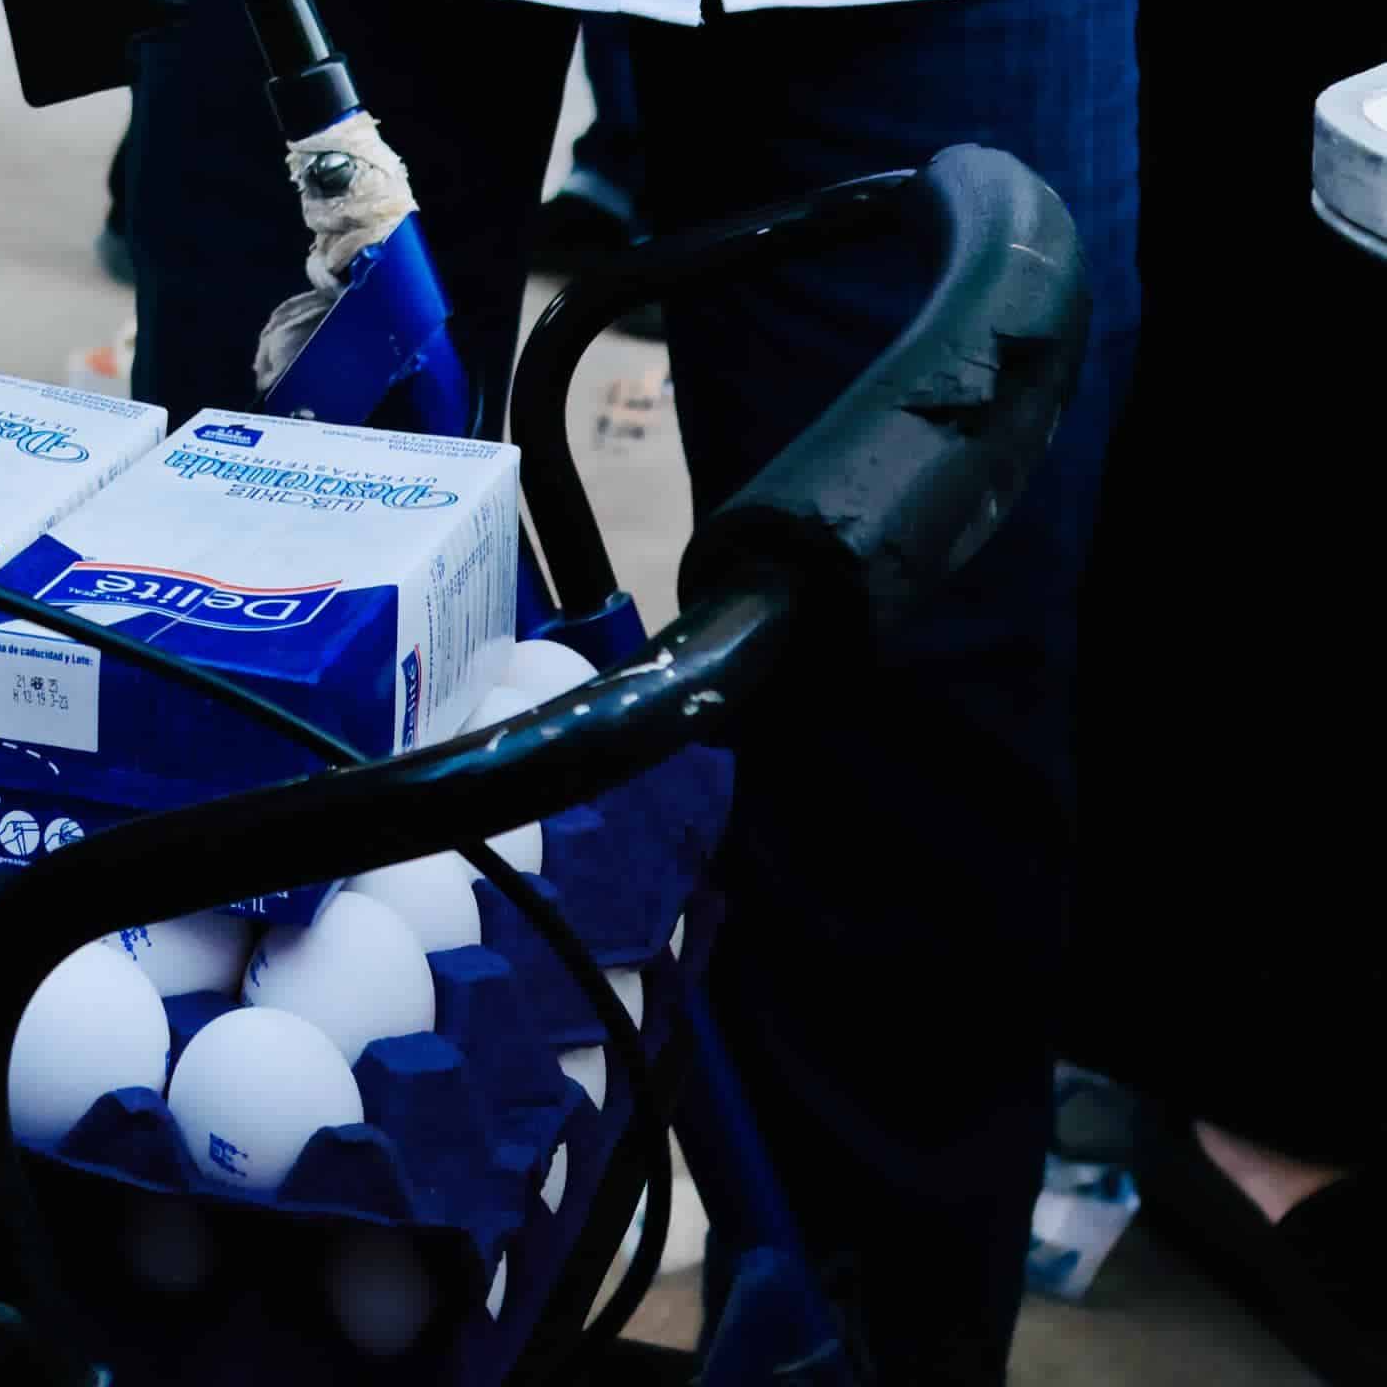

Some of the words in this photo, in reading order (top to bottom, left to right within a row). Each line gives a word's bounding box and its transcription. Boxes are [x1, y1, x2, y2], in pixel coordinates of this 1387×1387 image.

[163, 449, 459, 510] Descremada
[225, 483, 366, 513] LECHE
[95, 573, 302, 621] Delité
[8, 643, 19, 655] de
[20, 647, 63, 662] caducidad
